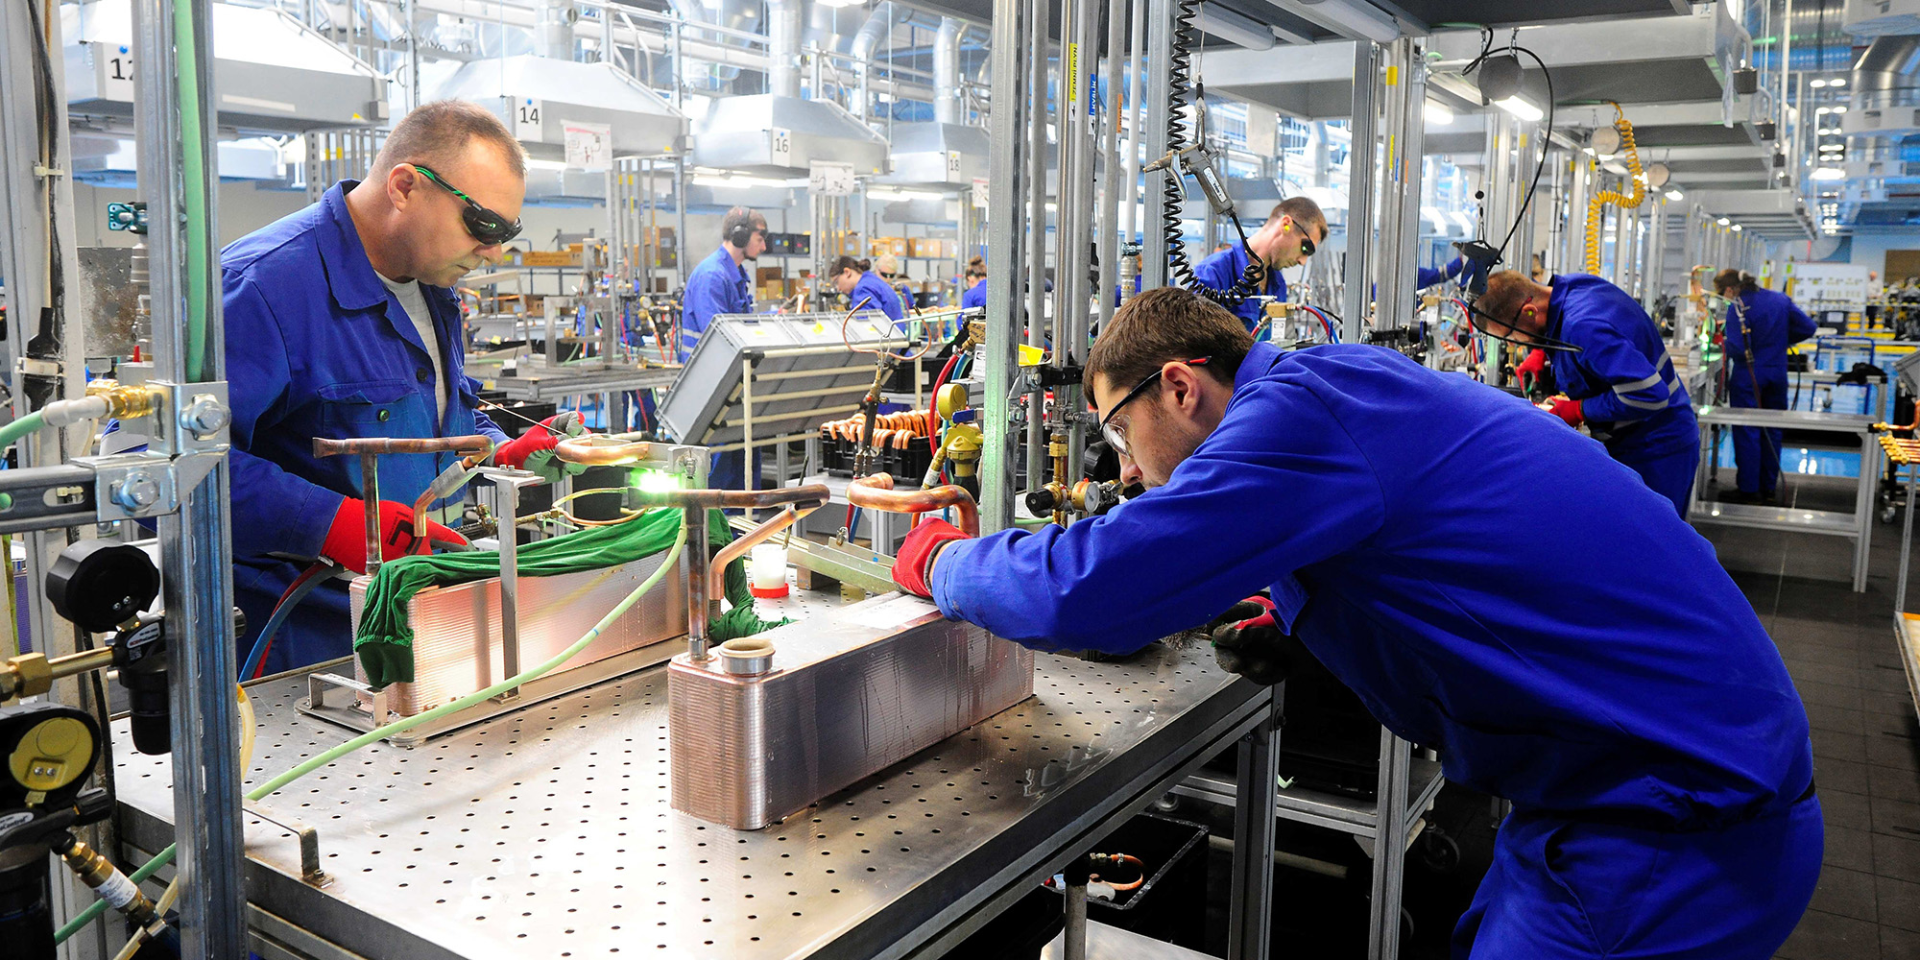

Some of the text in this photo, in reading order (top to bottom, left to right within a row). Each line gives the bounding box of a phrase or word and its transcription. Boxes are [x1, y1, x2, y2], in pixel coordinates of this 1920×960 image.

[519, 106, 540, 125] 14
[775, 137, 788, 152] 16
[949, 158, 960, 172] 18
